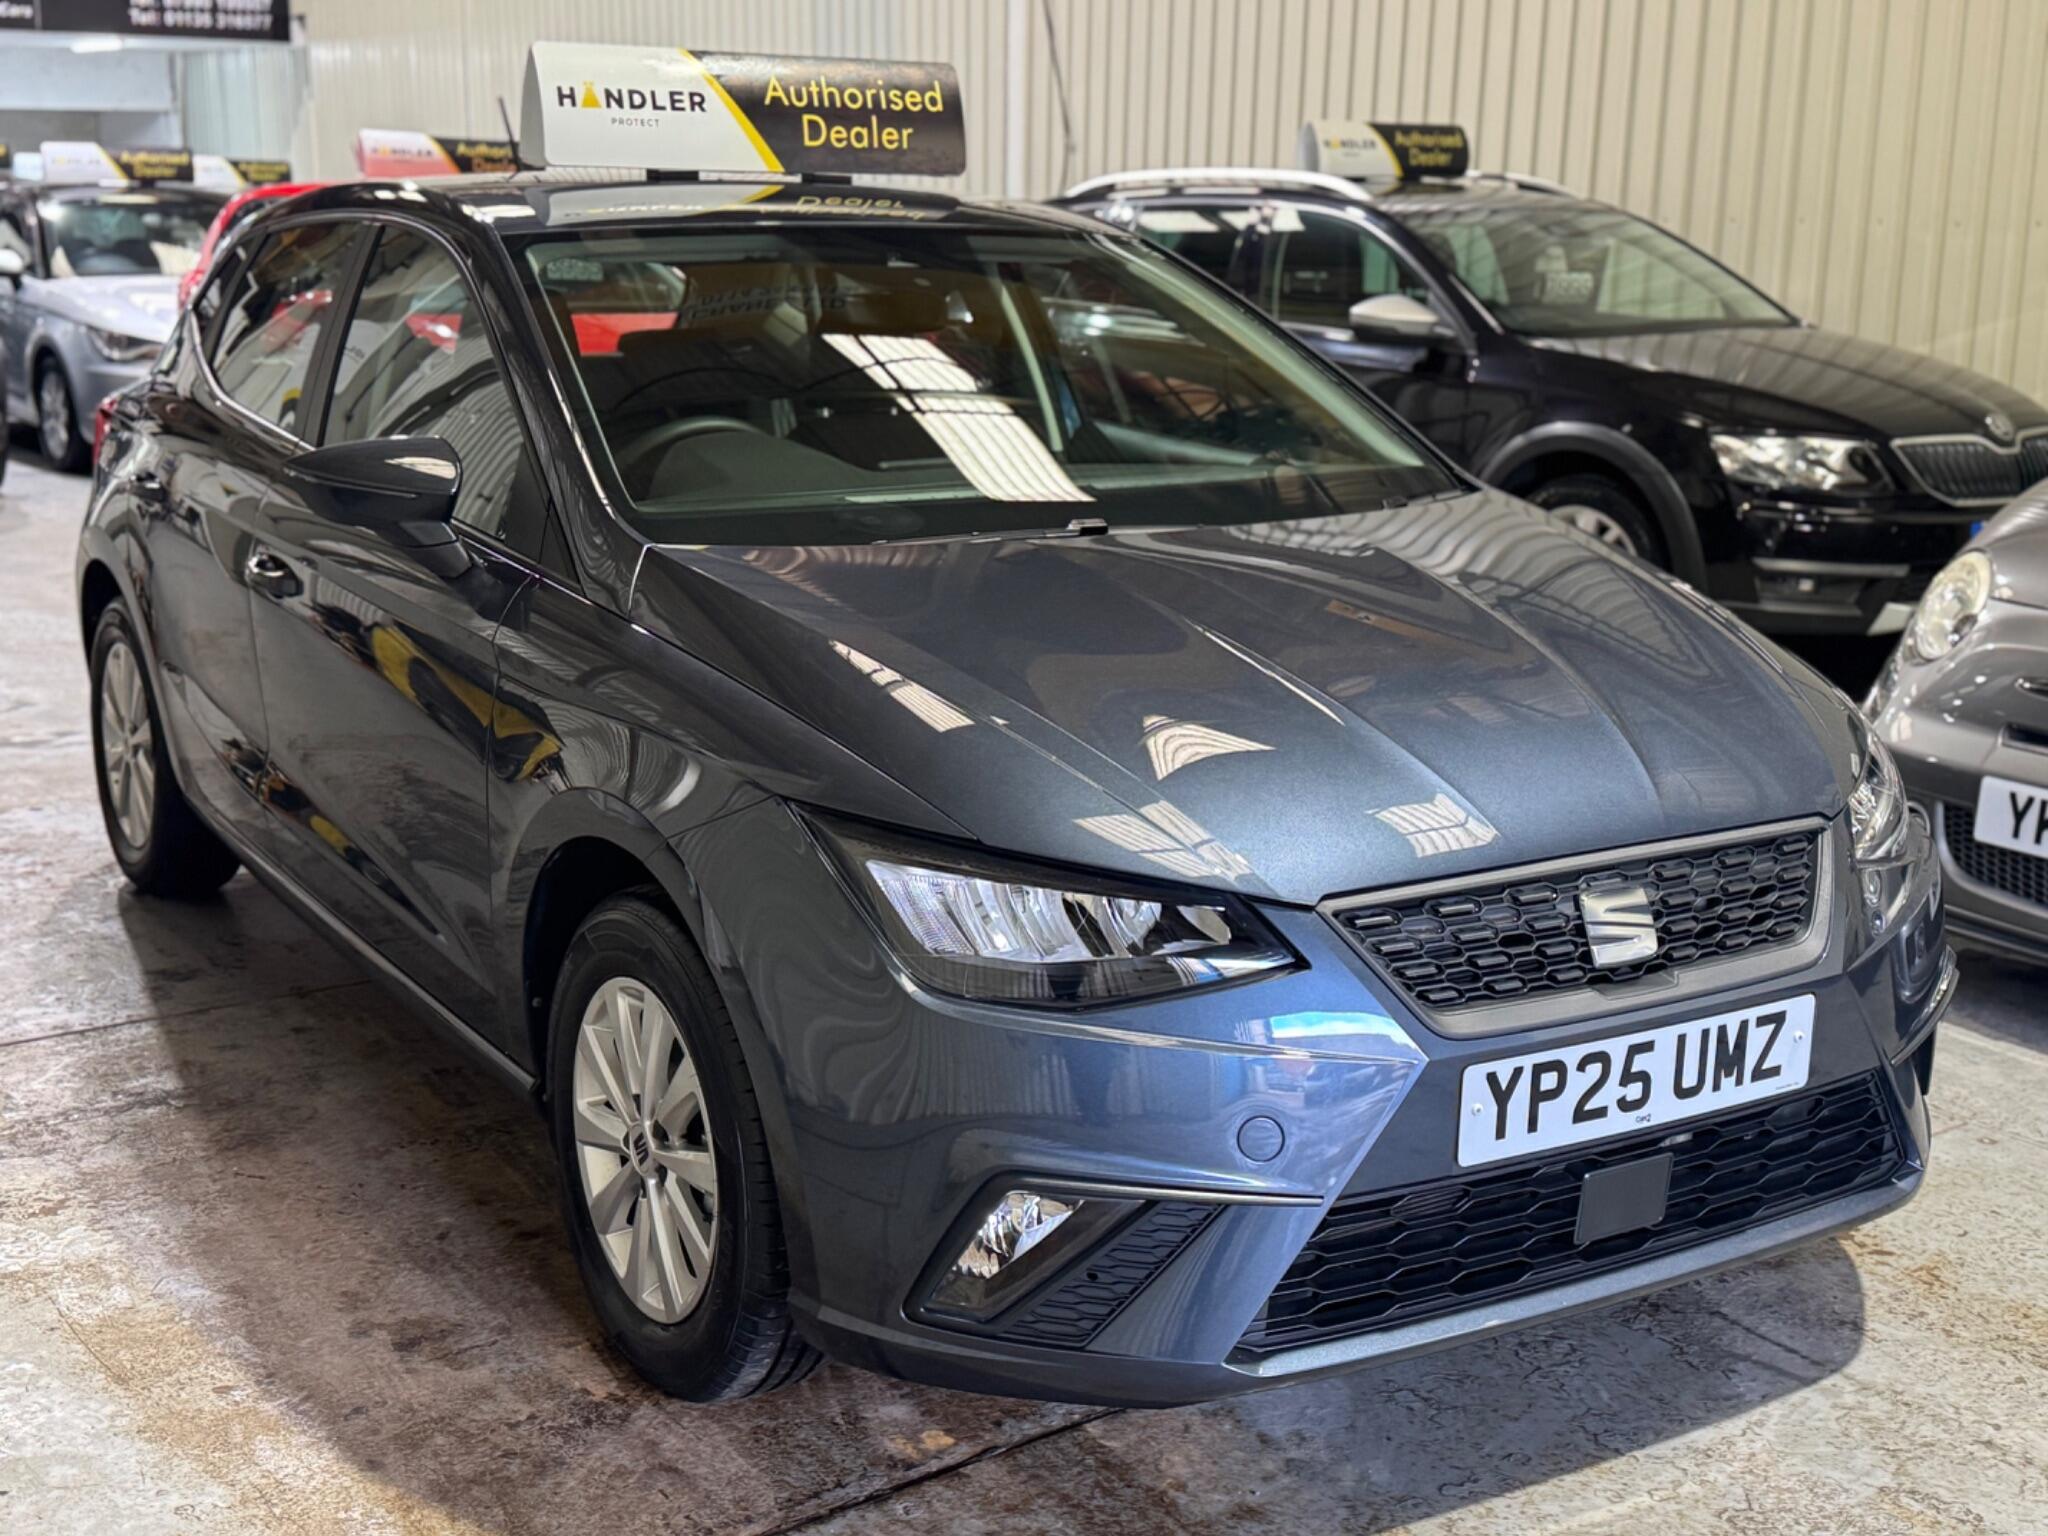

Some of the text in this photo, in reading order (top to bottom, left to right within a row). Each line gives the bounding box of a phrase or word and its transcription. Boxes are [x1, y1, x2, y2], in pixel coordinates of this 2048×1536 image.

[764, 75, 944, 113] Authorised
[611, 117, 660, 127] PROTECT
[802, 114, 914, 149] Dealer
[1486, 1011, 1788, 1141] YP25 UMZ
